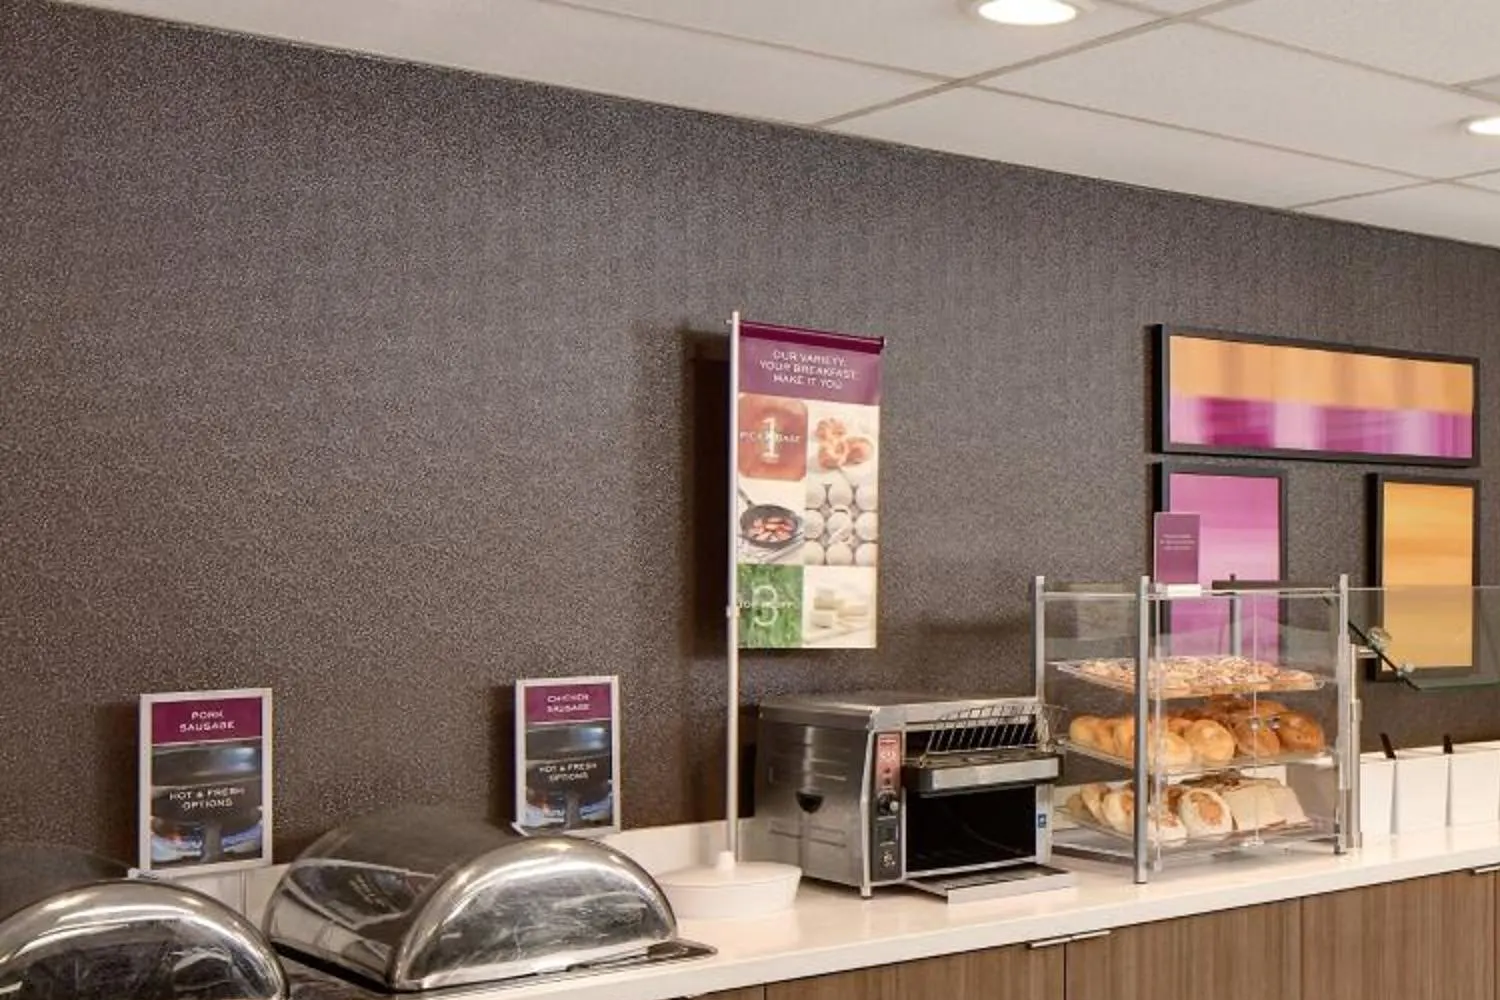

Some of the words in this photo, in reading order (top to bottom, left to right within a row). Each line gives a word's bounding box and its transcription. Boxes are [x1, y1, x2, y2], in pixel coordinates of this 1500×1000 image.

[191, 710, 224, 720] PORK
[179, 721, 235, 732] SAUSAGE
[169, 790, 192, 801] HOT
[182, 798, 232, 810] OPTIONS
